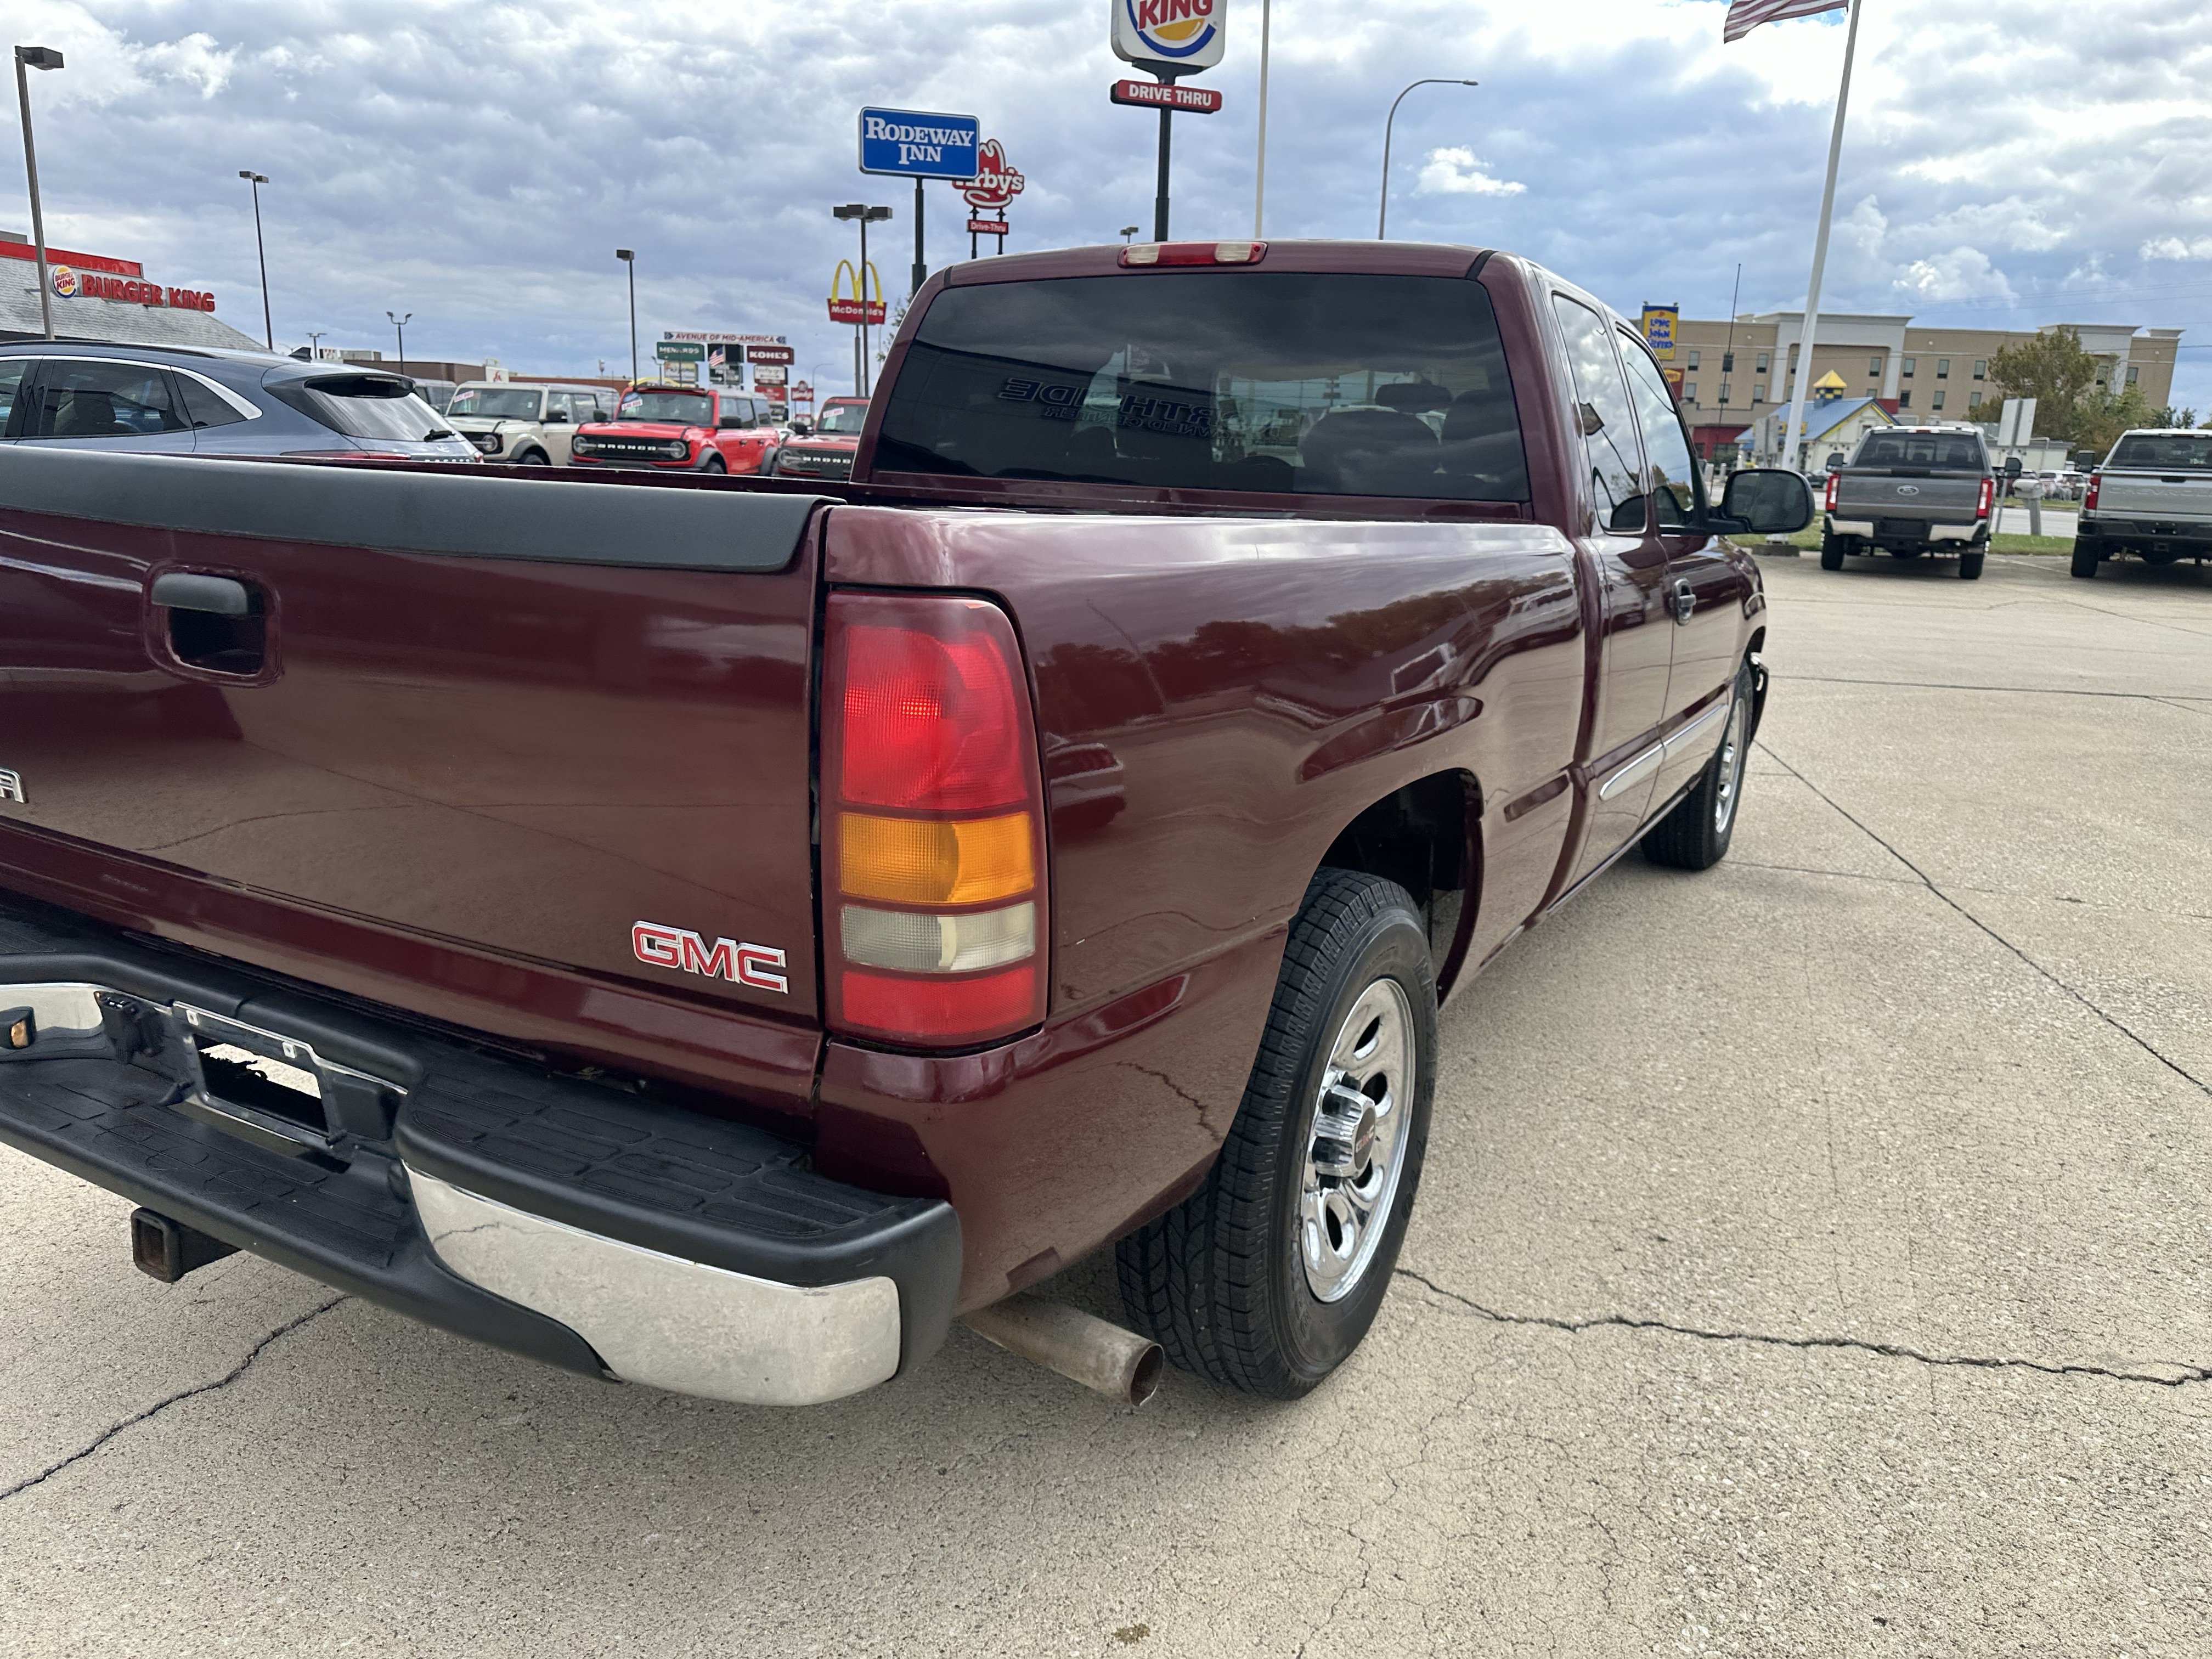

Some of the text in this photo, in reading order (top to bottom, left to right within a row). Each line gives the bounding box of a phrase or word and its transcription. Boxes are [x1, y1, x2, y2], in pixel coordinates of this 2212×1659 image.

[1129, 84, 1212, 106] DRIVE THRU
[898, 144, 943, 165] INN
[955, 166, 1024, 195] rby's
[970, 221, 1007, 233] Drive-Thru
[55, 272, 74, 282] BURGER
[57, 278, 75, 290] KING
[82, 274, 216, 312] BURGER KING
[831, 306, 884, 317] McDonld's
[1650, 318, 1671, 328] LONG
[722, 334, 774, 343] MID-AMERICA
[749, 351, 789, 360] KOHL'S
[597, 443, 656, 451] BRONCO
[632, 920, 788, 994] GMC
